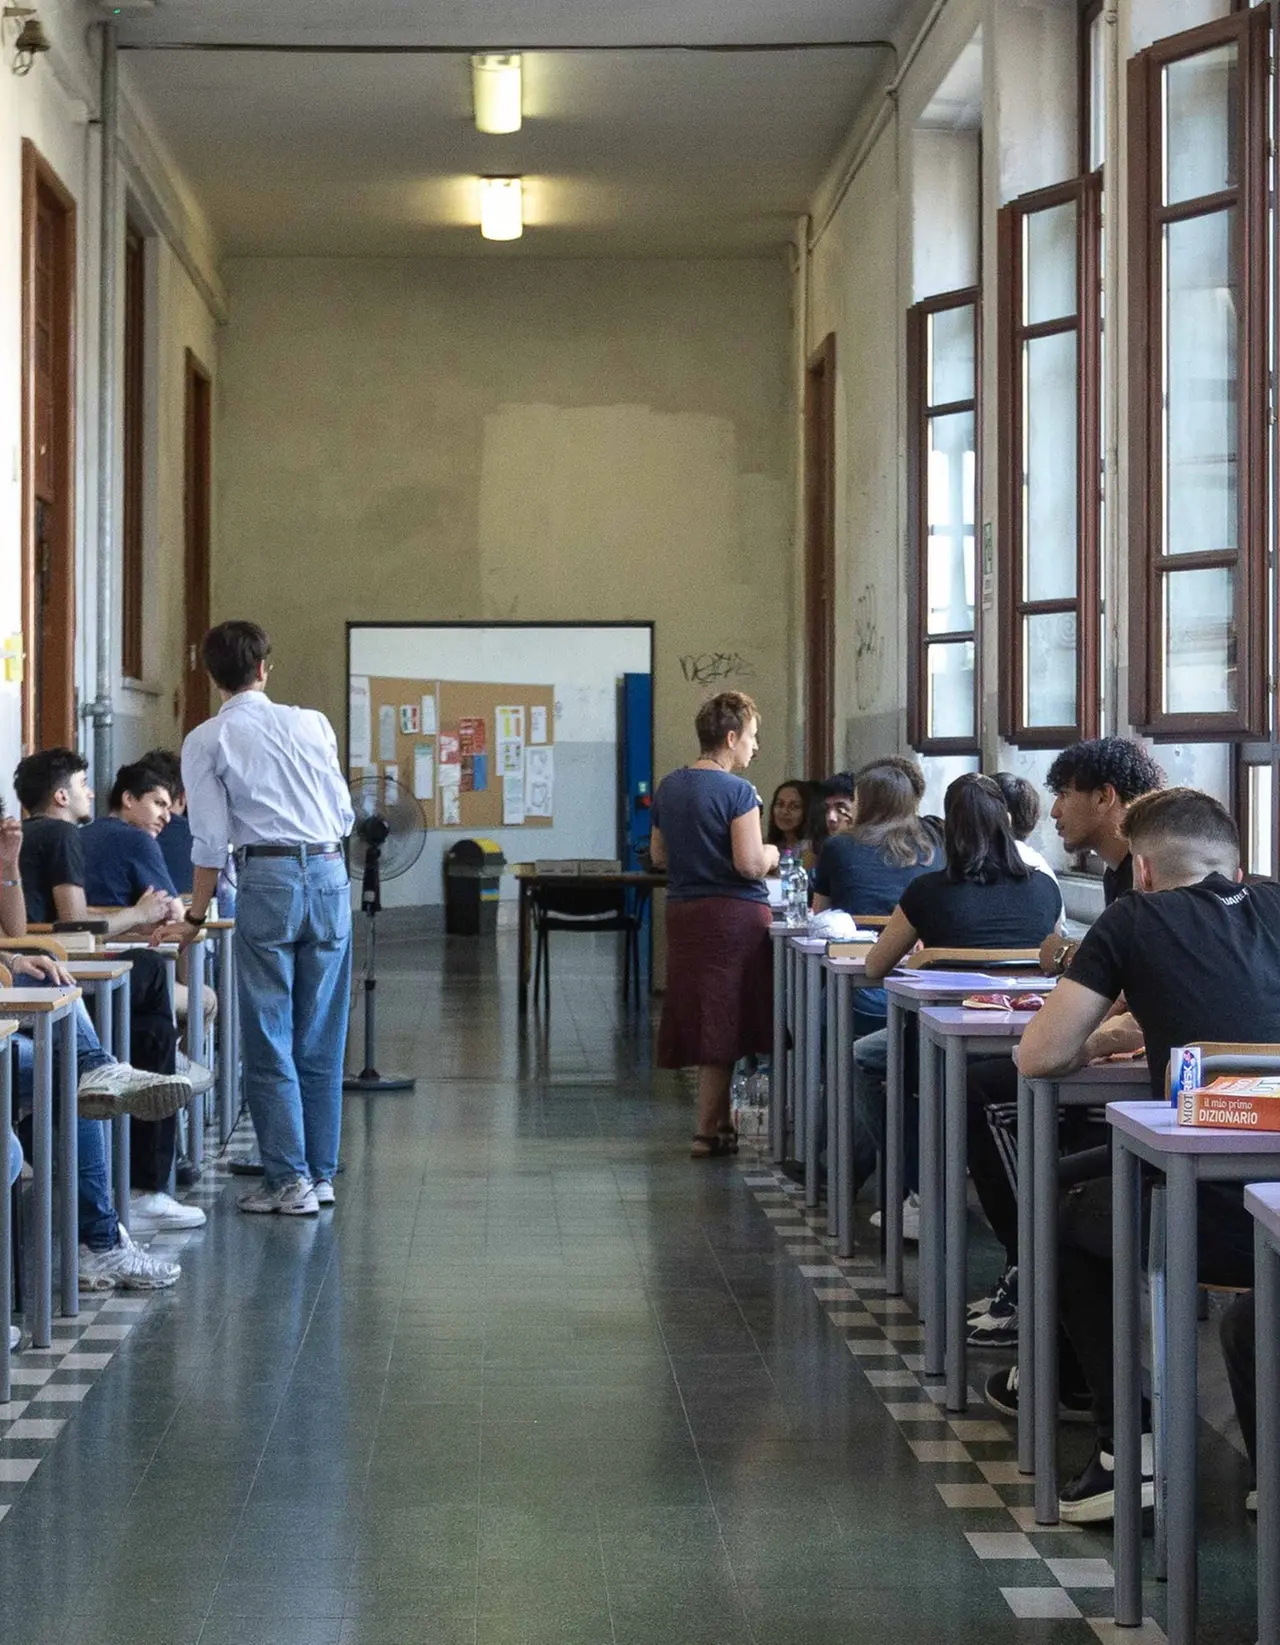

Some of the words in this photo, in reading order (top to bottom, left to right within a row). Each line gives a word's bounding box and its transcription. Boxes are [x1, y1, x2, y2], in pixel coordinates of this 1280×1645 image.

[1181, 1065, 1193, 1092] RISK
[1204, 1097, 1210, 1108] il
[1211, 1098, 1227, 1109] mio
[1228, 1098, 1253, 1111] primo
[1199, 1109, 1258, 1125] DIZIONARIO
